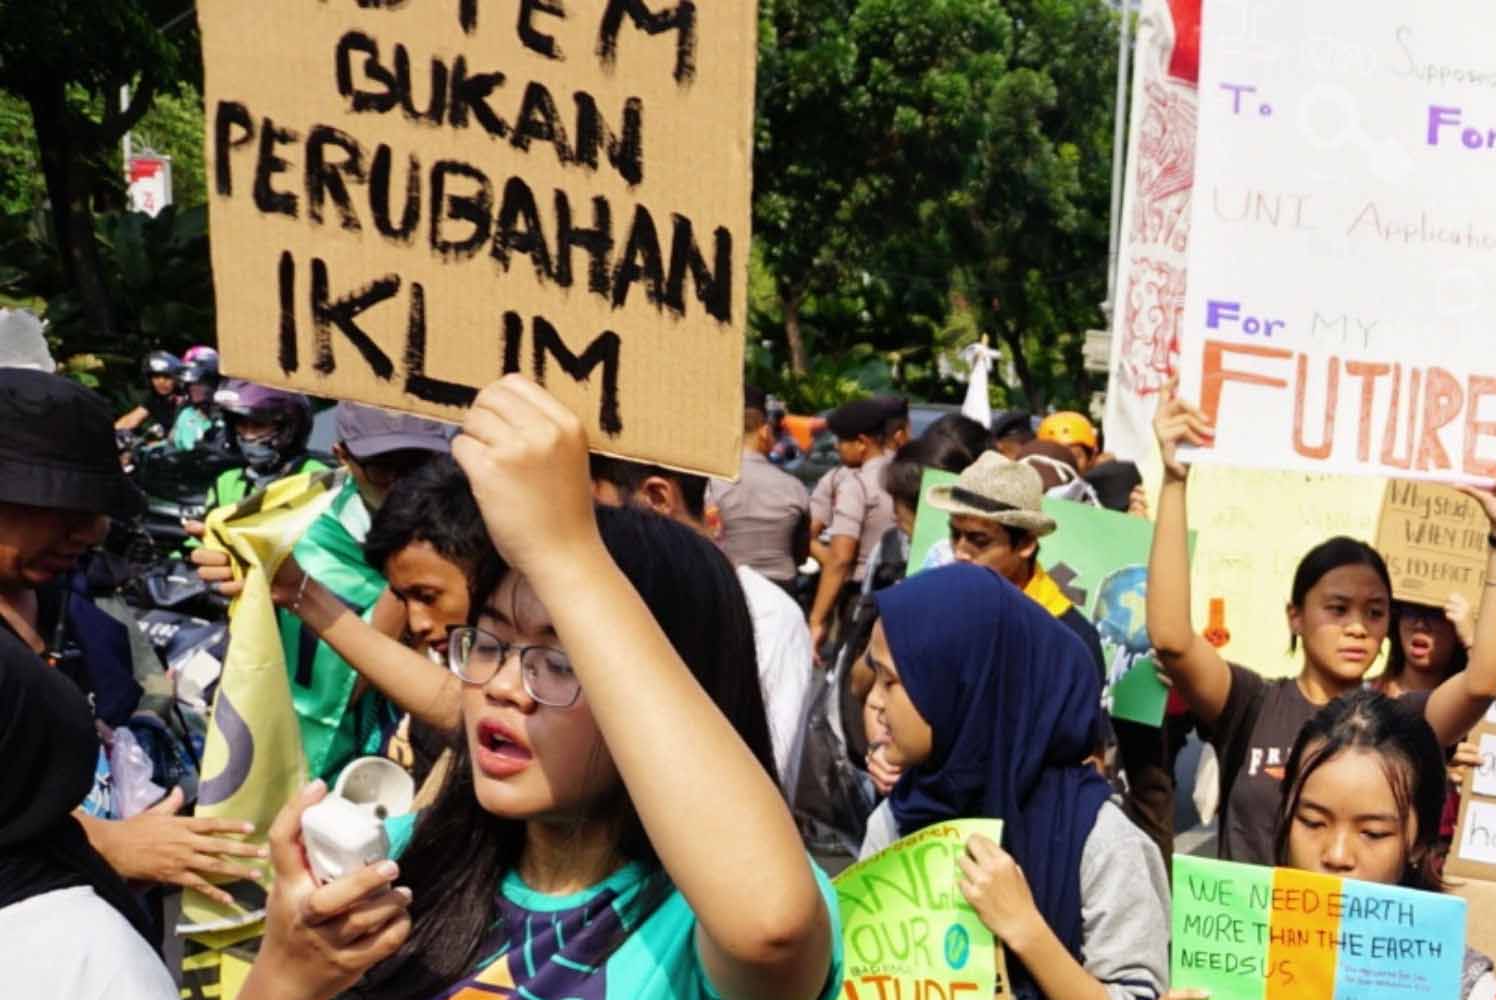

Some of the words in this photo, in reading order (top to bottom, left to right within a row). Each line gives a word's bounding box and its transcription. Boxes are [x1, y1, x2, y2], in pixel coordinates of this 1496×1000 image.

[335, 30, 643, 186] BUKAN
[1219, 82, 1272, 117] To
[215, 100, 732, 324] PERUBAHAN
[278, 250, 622, 437] IKLIM
[1205, 301, 1286, 337] For
[1189, 876, 1233, 906] WE
[1249, 885, 1319, 914] NEED
[1328, 893, 1415, 927] EARTH
[852, 917, 933, 966] OUR
[1183, 914, 1244, 943] MORE
[1253, 922, 1309, 947] THAN
[1317, 930, 1363, 957] THE
[1371, 936, 1442, 959] EARTH
[1181, 948, 1256, 975] NEEDS
[1262, 959, 1295, 984] US
